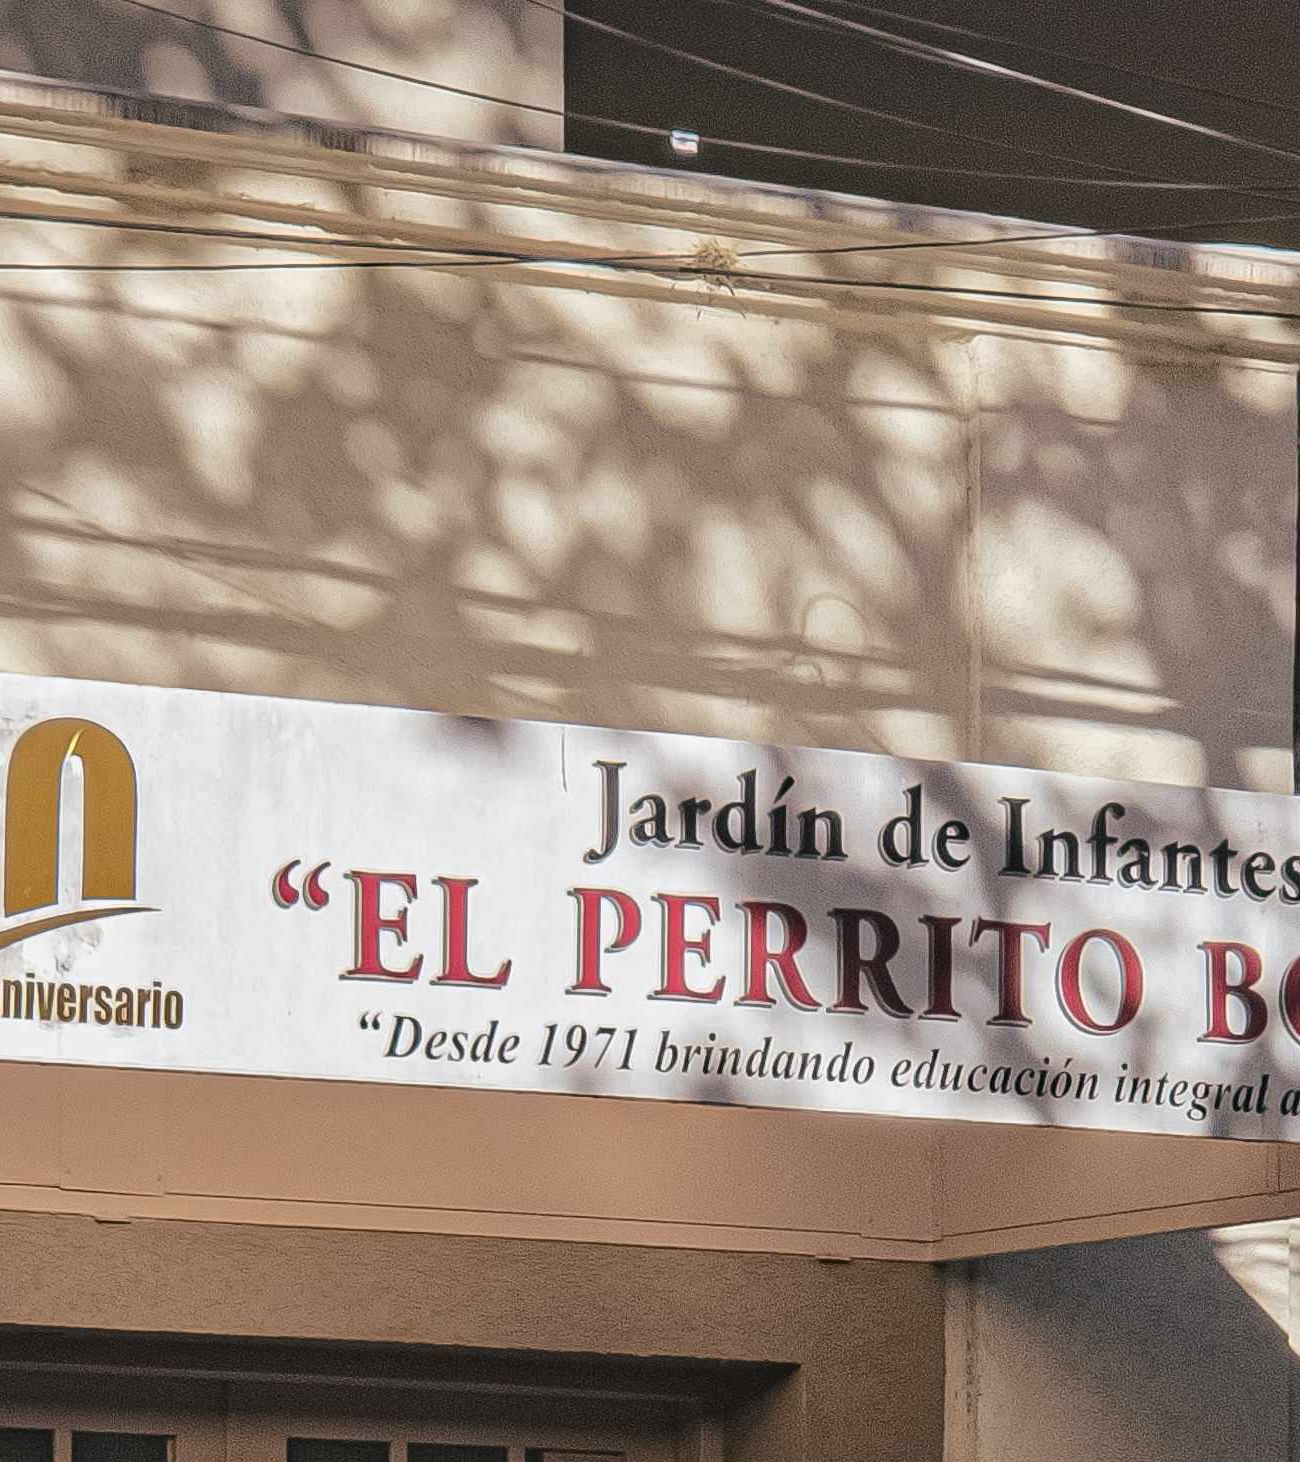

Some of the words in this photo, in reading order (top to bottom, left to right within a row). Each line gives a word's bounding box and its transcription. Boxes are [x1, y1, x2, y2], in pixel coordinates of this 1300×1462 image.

[583, 759, 848, 865] Jardín
[880, 783, 972, 871] de
[271, 858, 512, 990] “EL
[565, 886, 1144, 1037] PERRITO
[358, 1011, 521, 1065] “Desde
[536, 1023, 638, 1072] 1971
[655, 1029, 875, 1085] brindando
[890, 1048, 1100, 1102] educación
[1114, 1063, 1267, 1121] integral
